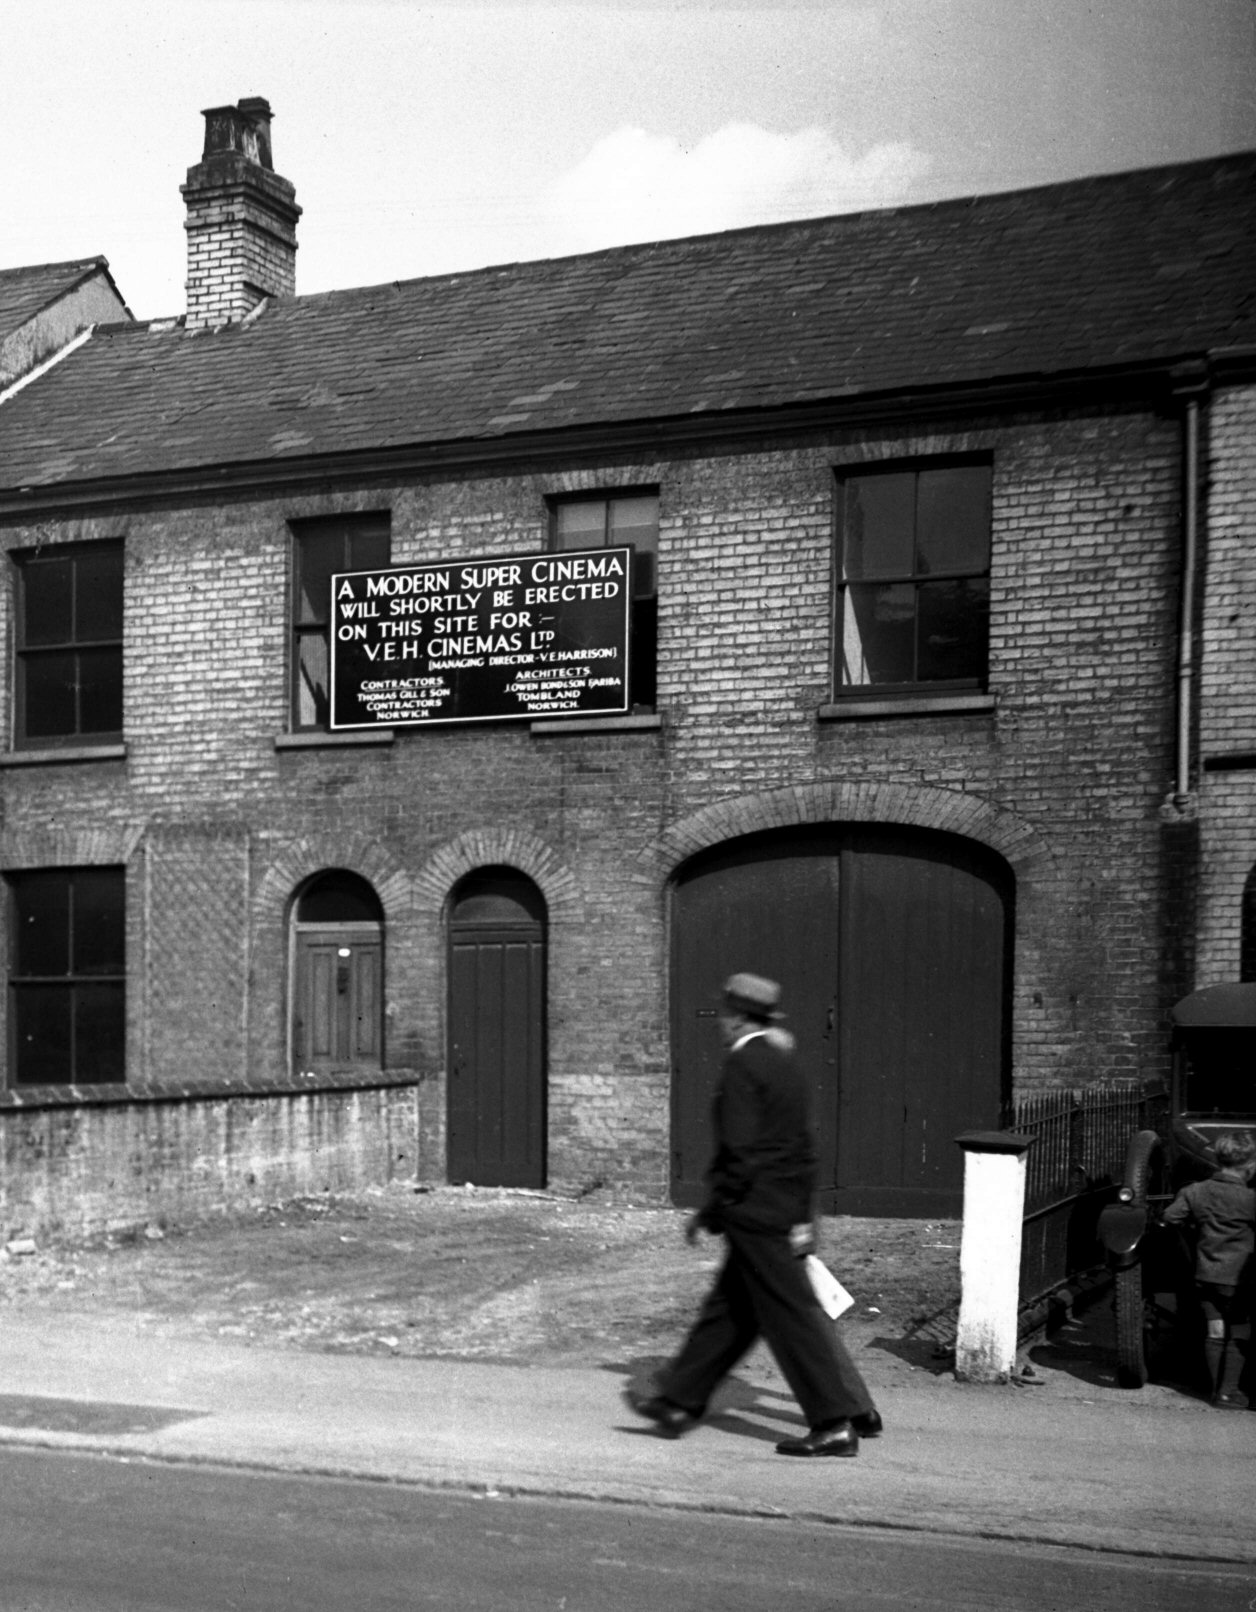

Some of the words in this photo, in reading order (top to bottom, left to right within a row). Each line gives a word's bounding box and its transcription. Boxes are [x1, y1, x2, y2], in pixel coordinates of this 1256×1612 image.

[338, 580, 355, 600] A
[367, 571, 450, 598] MODERN
[461, 565, 522, 590] SUPER
[532, 556, 624, 583] CINEMA
[341, 601, 381, 619] WILL
[390, 592, 482, 616] SHORTLY
[493, 590, 514, 607] BE
[525, 581, 620, 605] ERECTED
[338, 624, 367, 641] ON
[378, 619, 423, 638] THIS
[434, 615, 479, 634] SITE
[490, 611, 532, 630] FOR
[427, 632, 522, 658] CINEMAS
[357, 692, 396, 702] THOMAS
[399, 690, 417, 699] GILL
[419, 690, 426, 698] &
[430, 688, 450, 697] SON
[366, 698, 442, 711] CONTRACTORS
[516, 690, 581, 702] TOMBLAND
